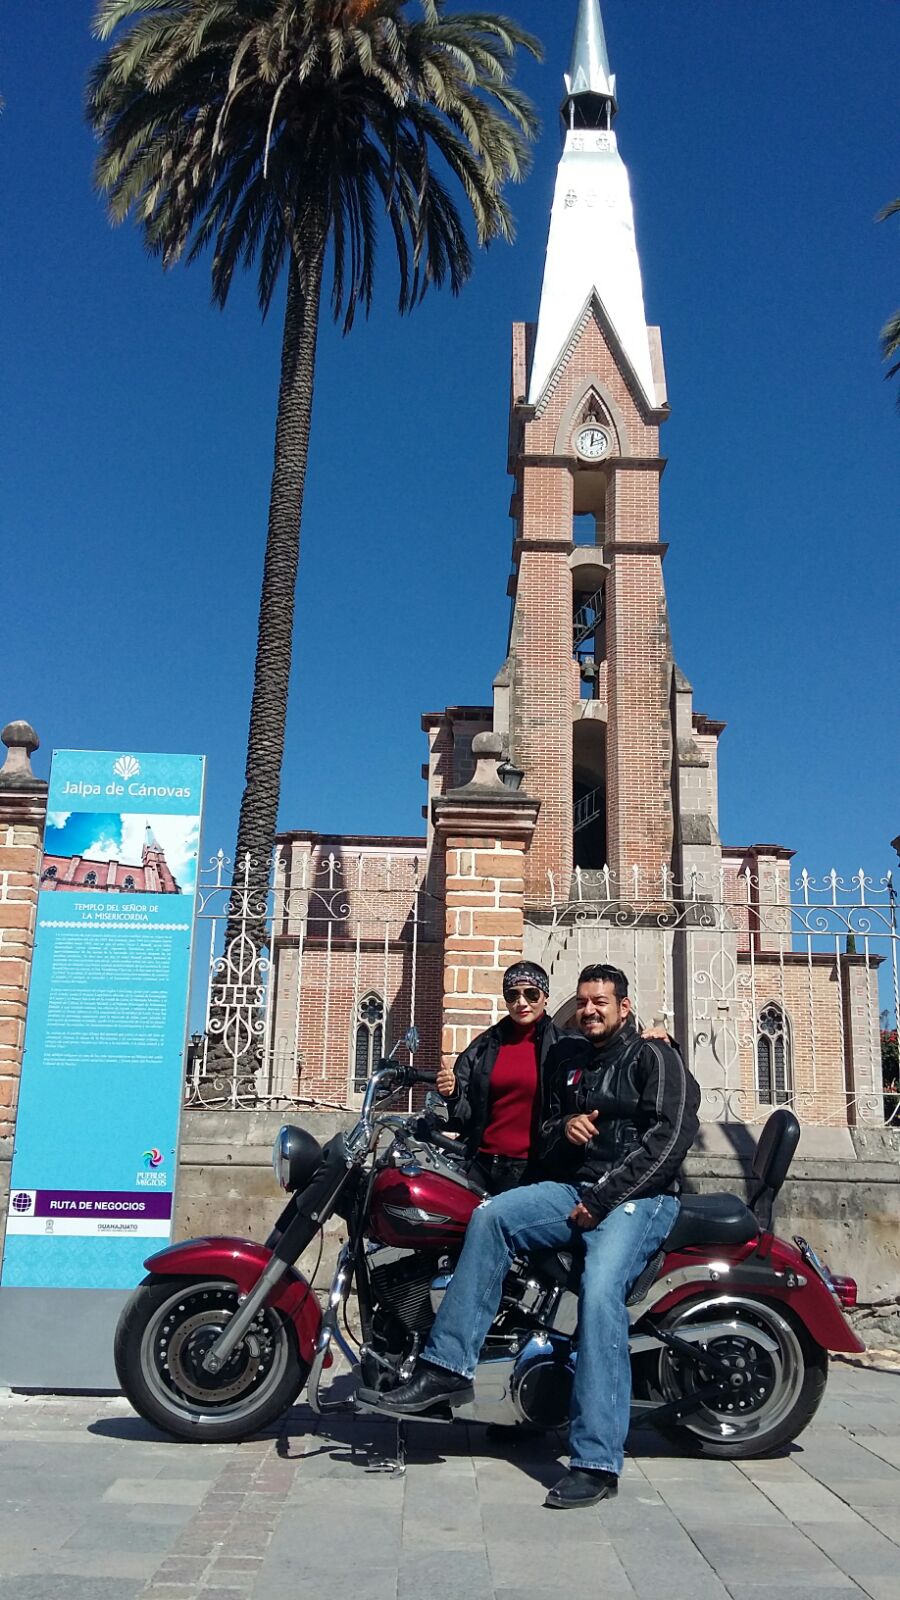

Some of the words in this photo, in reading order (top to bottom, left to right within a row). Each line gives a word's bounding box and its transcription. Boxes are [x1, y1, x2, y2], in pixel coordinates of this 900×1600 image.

[62, 781, 101, 797] Jalpa
[105, 782, 124, 795] de
[128, 782, 191, 798] Cánovas
[74, 903, 104, 912] TEMPLO
[121, 904, 147, 912] SEÑOR
[149, 905, 159, 913] DE
[95, 913, 149, 921] MISERICORDIA
[50, 1200, 77, 1210] RUTA
[78, 1201, 93, 1210] DE
[94, 1202, 146, 1211] NEGOCIOS
